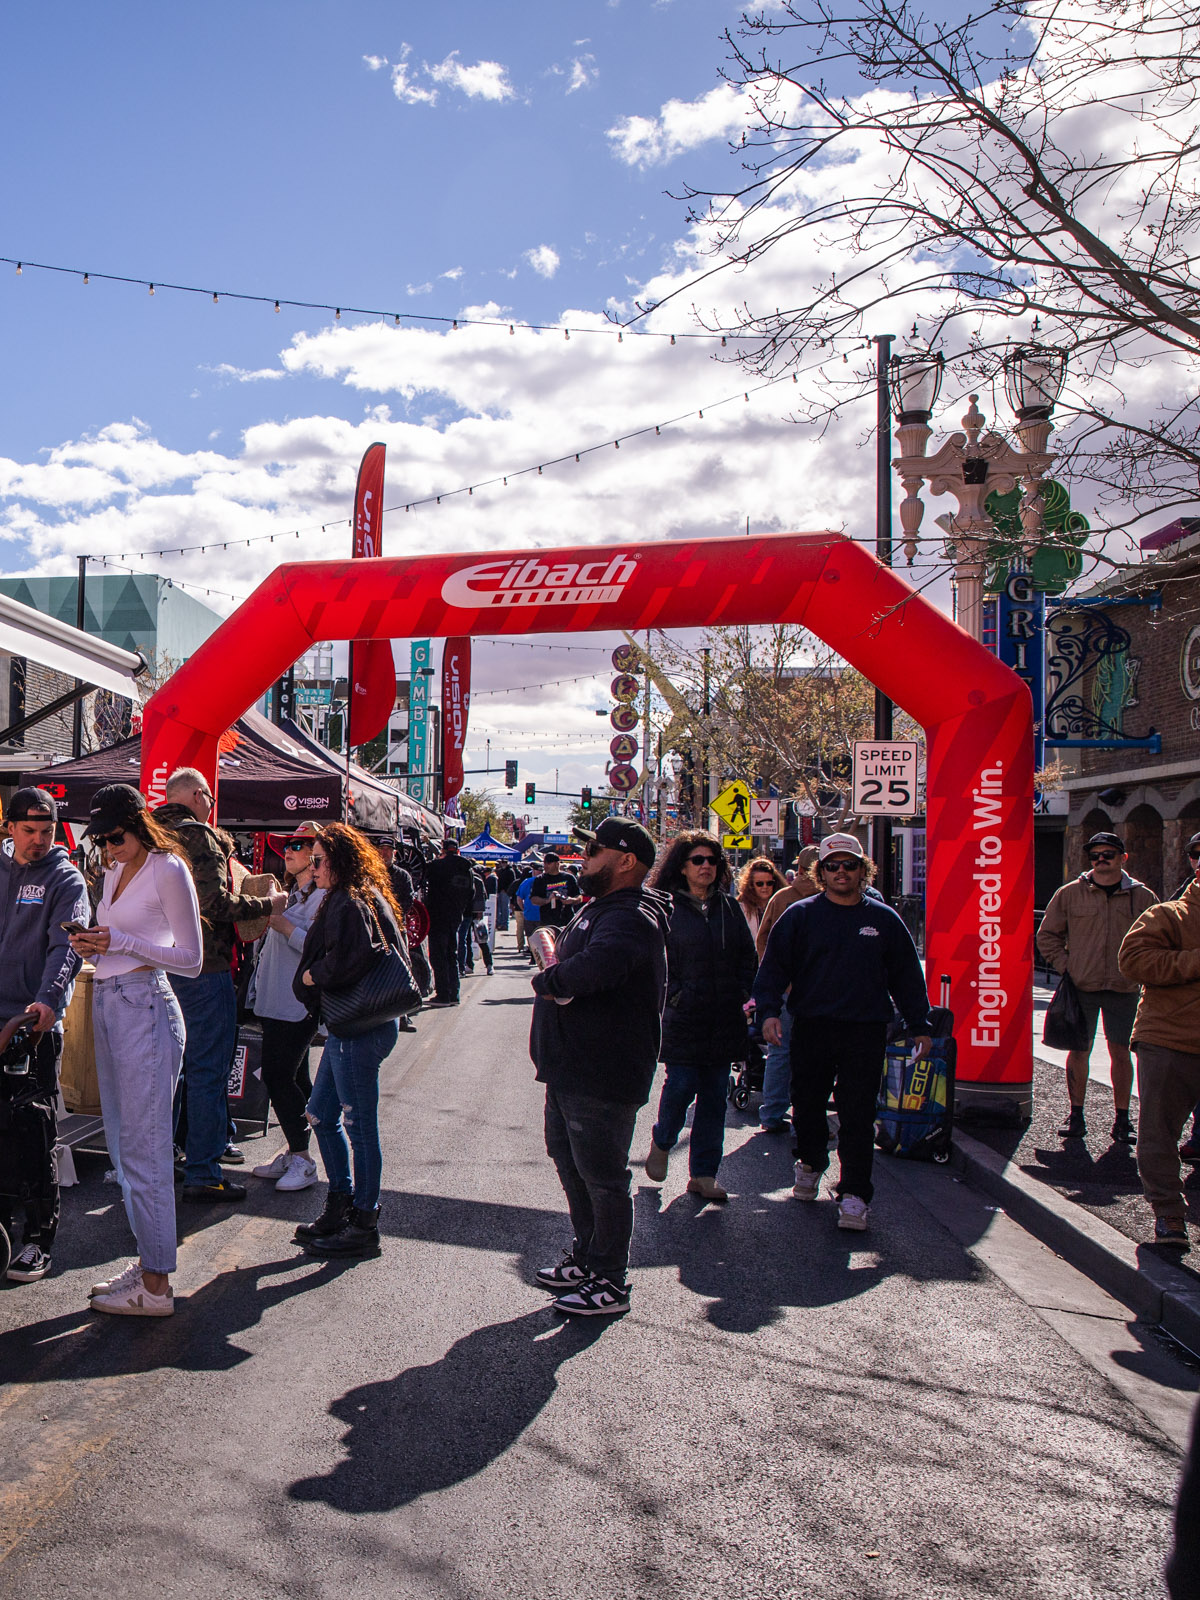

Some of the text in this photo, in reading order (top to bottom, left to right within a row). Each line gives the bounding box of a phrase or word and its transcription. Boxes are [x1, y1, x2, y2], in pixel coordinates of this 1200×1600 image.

[441, 554, 638, 608] Eibach
[410, 647, 427, 798] GAMBLING
[450, 655, 463, 749] VISION
[860, 750, 912, 761] SPEED
[865, 764, 907, 776] LIMIT
[860, 780, 911, 806] 25
[970, 760, 1008, 1048] Engineered to Win.
